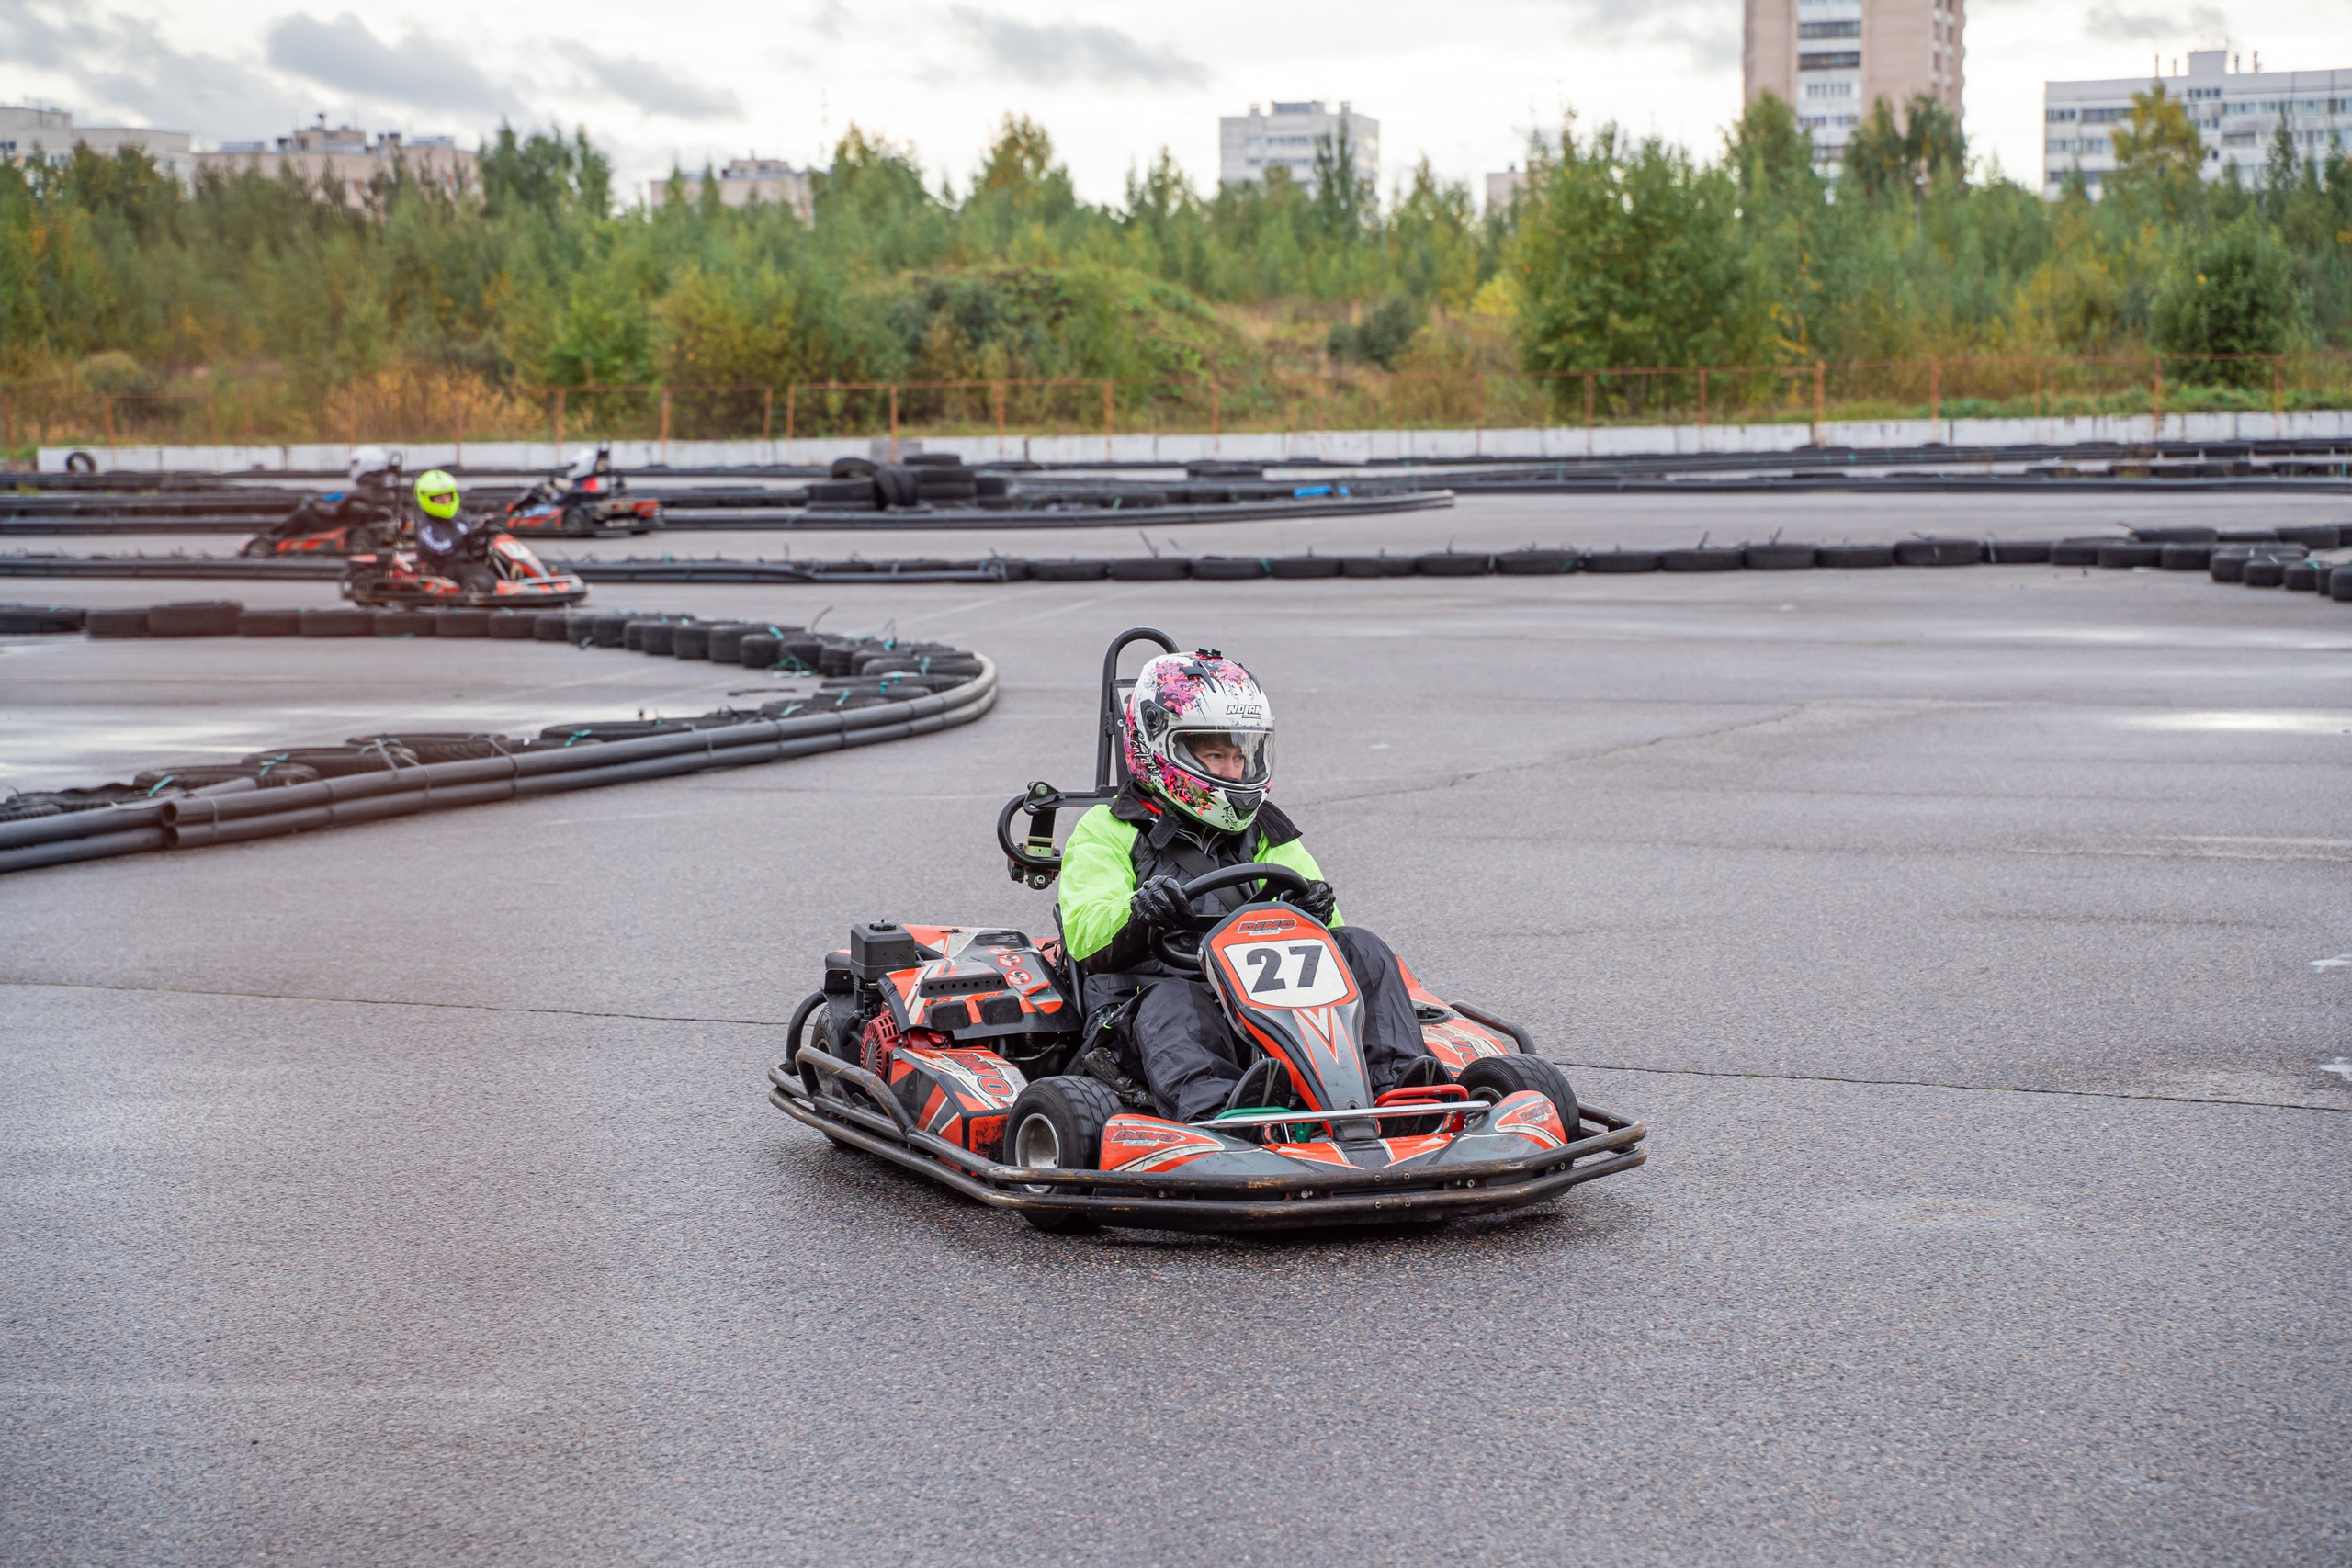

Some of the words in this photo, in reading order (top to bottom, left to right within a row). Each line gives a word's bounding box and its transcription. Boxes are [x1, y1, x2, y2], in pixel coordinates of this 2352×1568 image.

[1226, 704, 1262, 719] NOLAN
[1238, 919, 1296, 933] DINO
[1246, 945, 1323, 994] 27
[943, 1053, 1013, 1097] DINO
[1111, 1130, 1182, 1144] DINO
